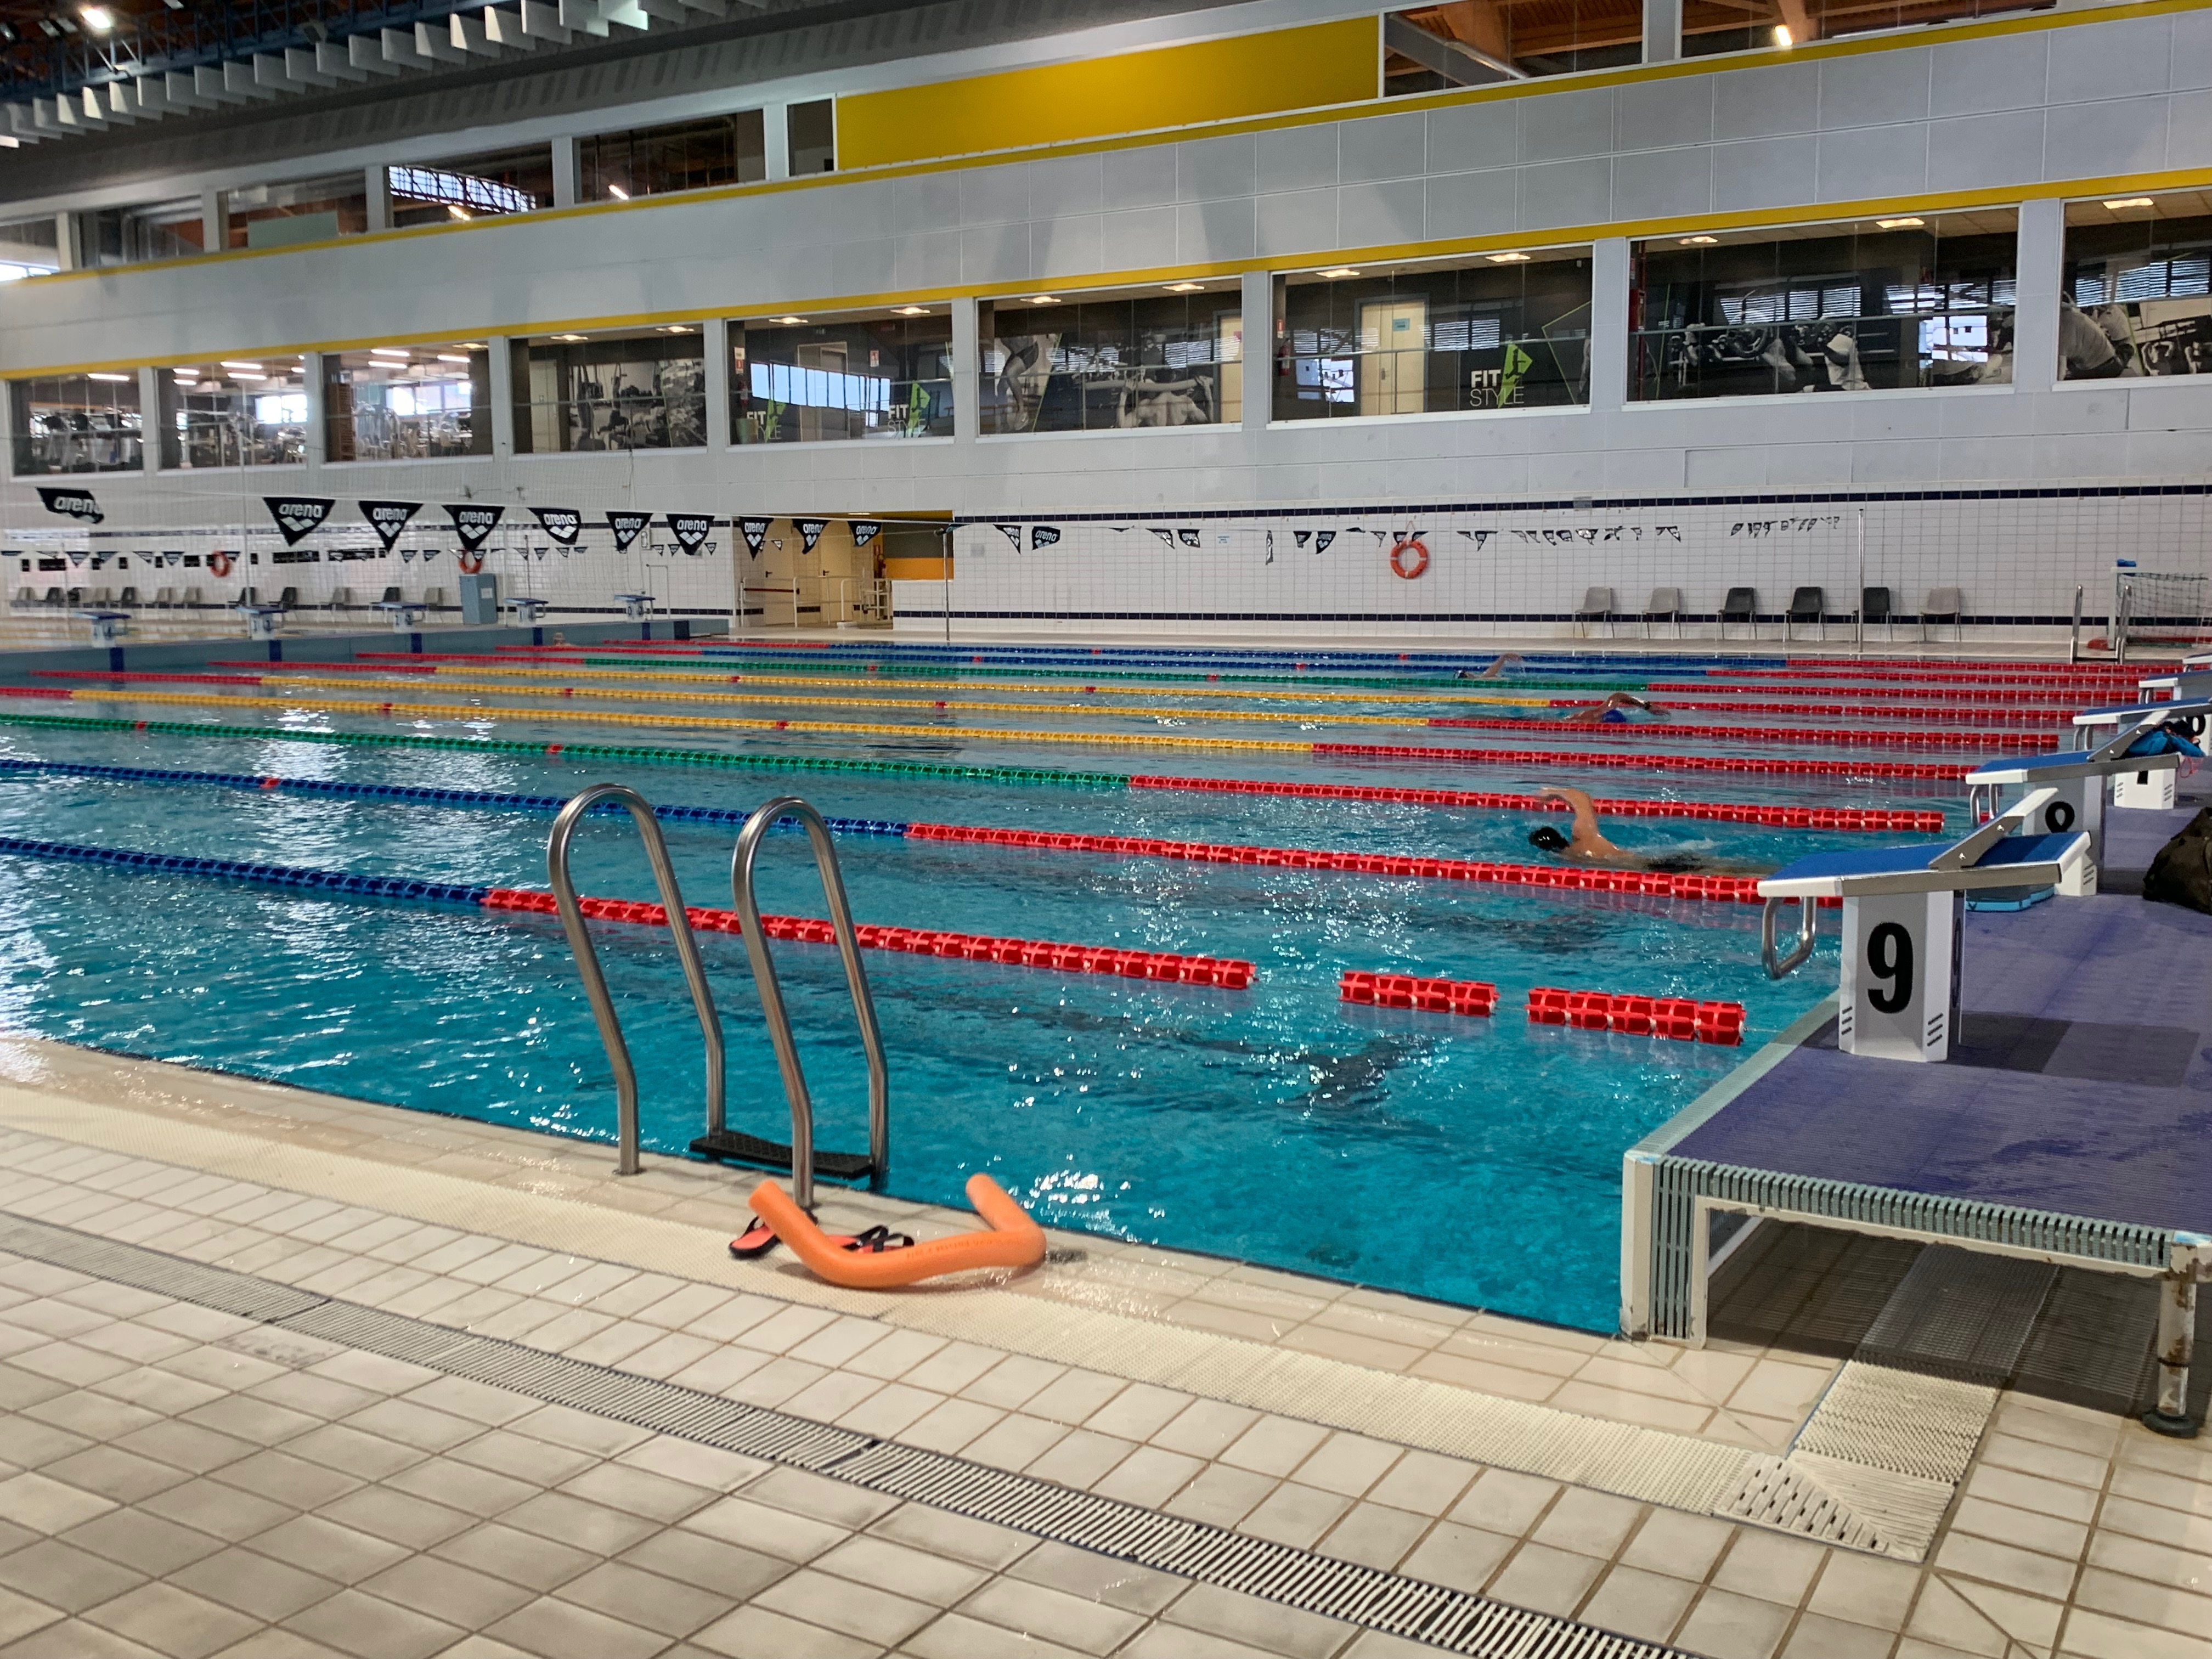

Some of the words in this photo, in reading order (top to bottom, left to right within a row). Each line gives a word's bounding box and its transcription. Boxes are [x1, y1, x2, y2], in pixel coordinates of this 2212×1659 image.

[1471, 369, 1502, 388] FIT
[1470, 386, 1525, 407] STYLE
[888, 404, 909, 420] FIT
[278, 504, 323, 518] arena
[373, 507, 408, 521] arena
[459, 511, 494, 524] arena
[543, 514, 577, 526] arena
[614, 517, 642, 529] arena
[676, 520, 707, 531] arena
[744, 522, 765, 533] arena
[803, 523, 822, 534] arena
[856, 525, 877, 535] arena
[1035, 529, 1058, 542] arena
[1867, 922, 1914, 1014] 9
